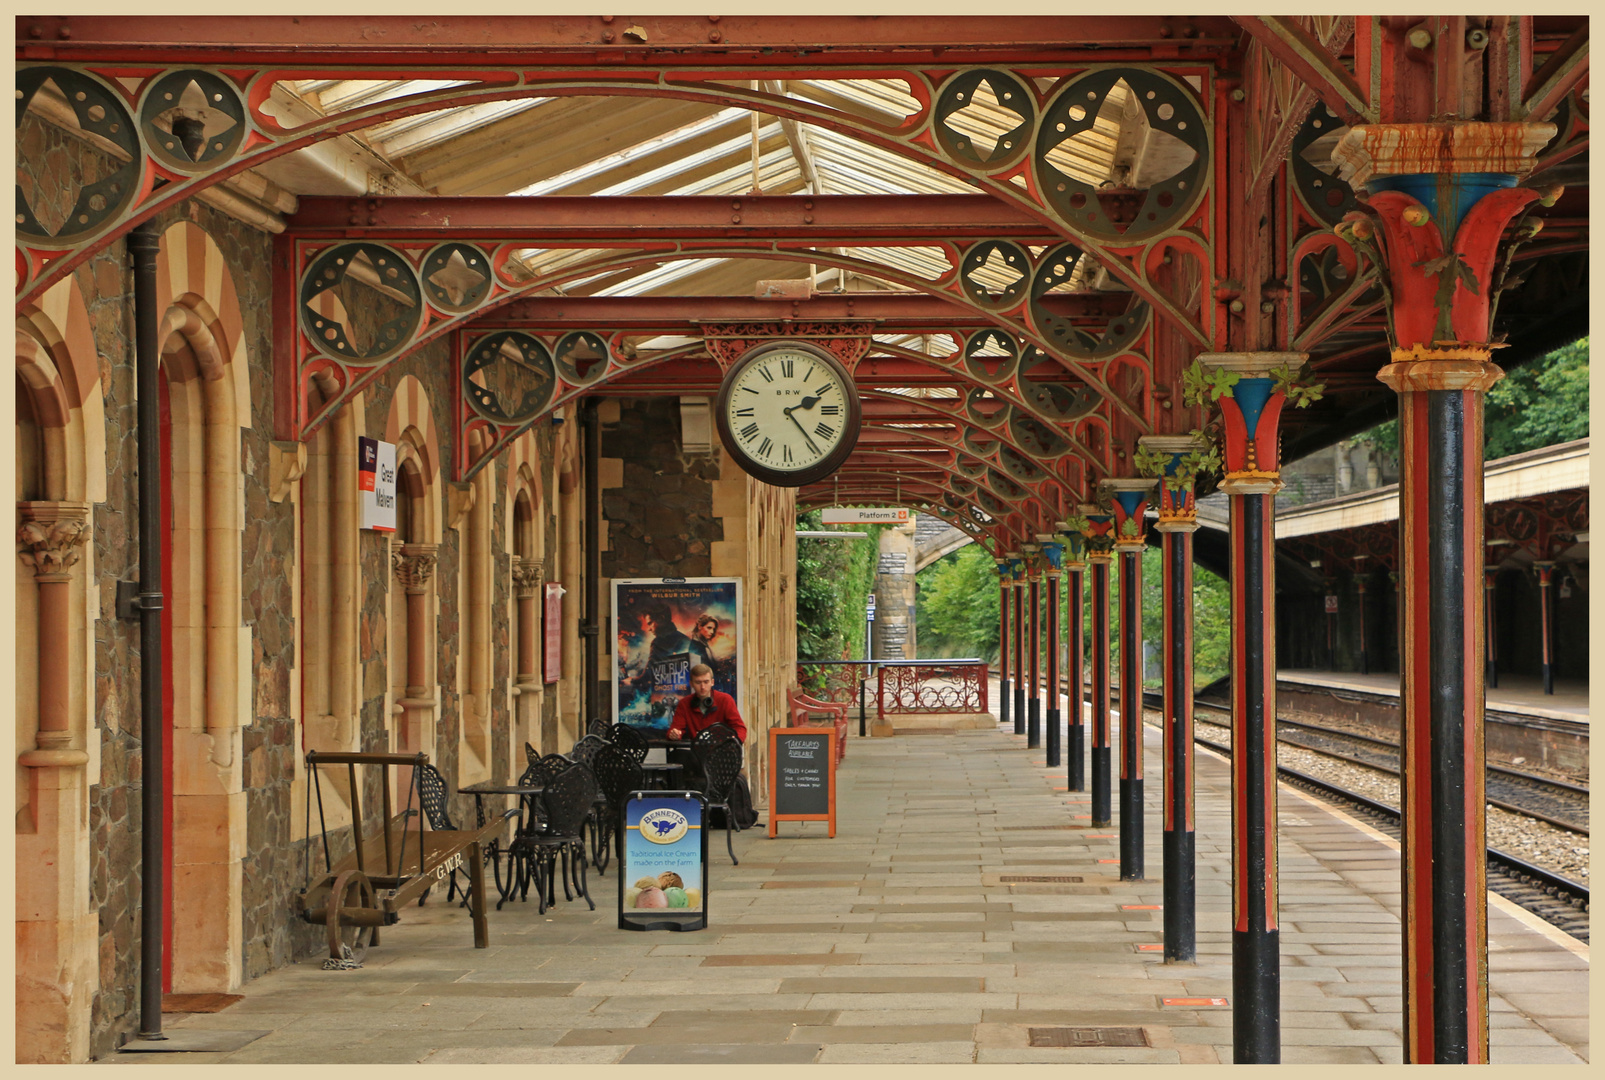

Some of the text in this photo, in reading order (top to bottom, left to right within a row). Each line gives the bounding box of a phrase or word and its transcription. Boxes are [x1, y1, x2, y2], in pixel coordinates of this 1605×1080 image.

[381, 463, 394, 484] Great
[376, 487, 394, 509] Malvern
[859, 511, 890, 519] Platform
[651, 661, 689, 676] WILBUR
[654, 672, 686, 685] SMITH
[675, 683, 687, 691] FIRE
[643, 810, 685, 824] BENNETTS
[630, 850, 663, 858] Traditional
[675, 850, 697, 858] Cream
[677, 859, 693, 867] farm
